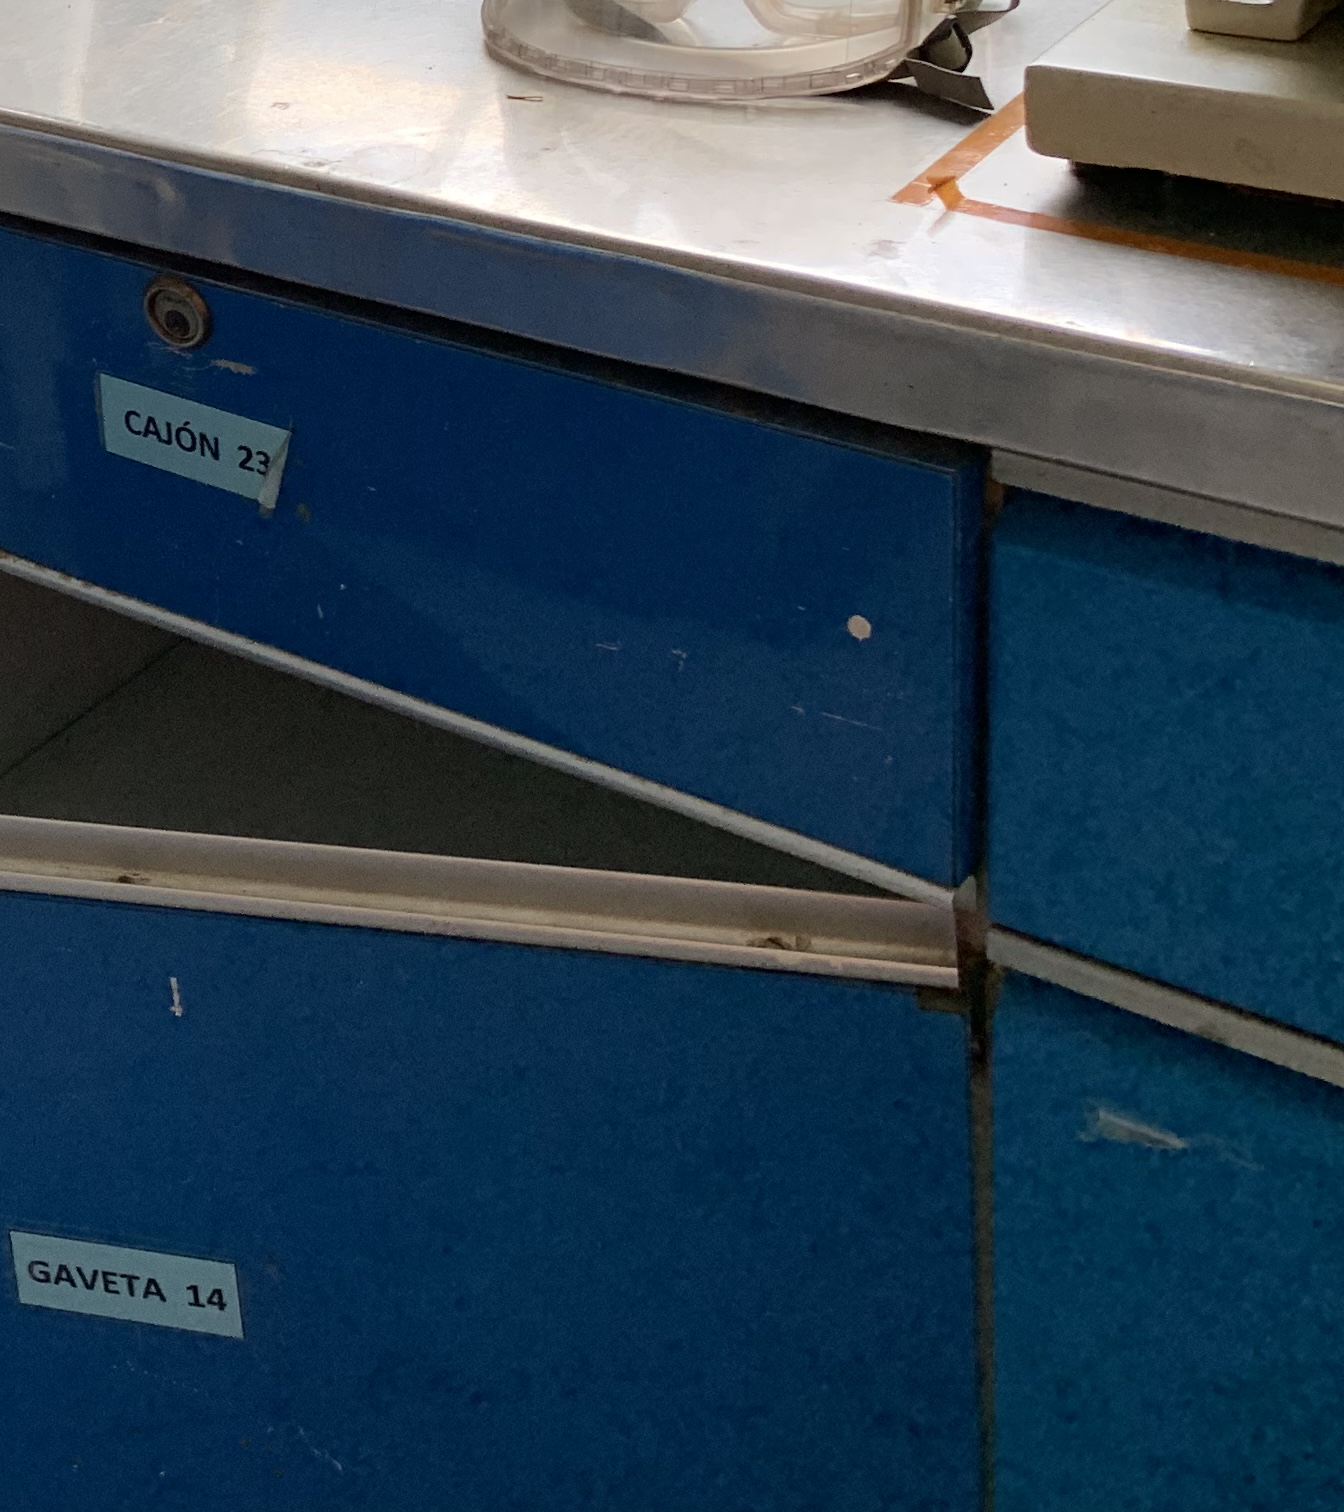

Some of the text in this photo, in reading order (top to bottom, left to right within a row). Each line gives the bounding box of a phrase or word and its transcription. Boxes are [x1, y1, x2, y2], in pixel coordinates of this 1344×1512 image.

[124, 410, 270, 475] CAJÓN 23
[27, 1260, 227, 1311] GAVETA 14
